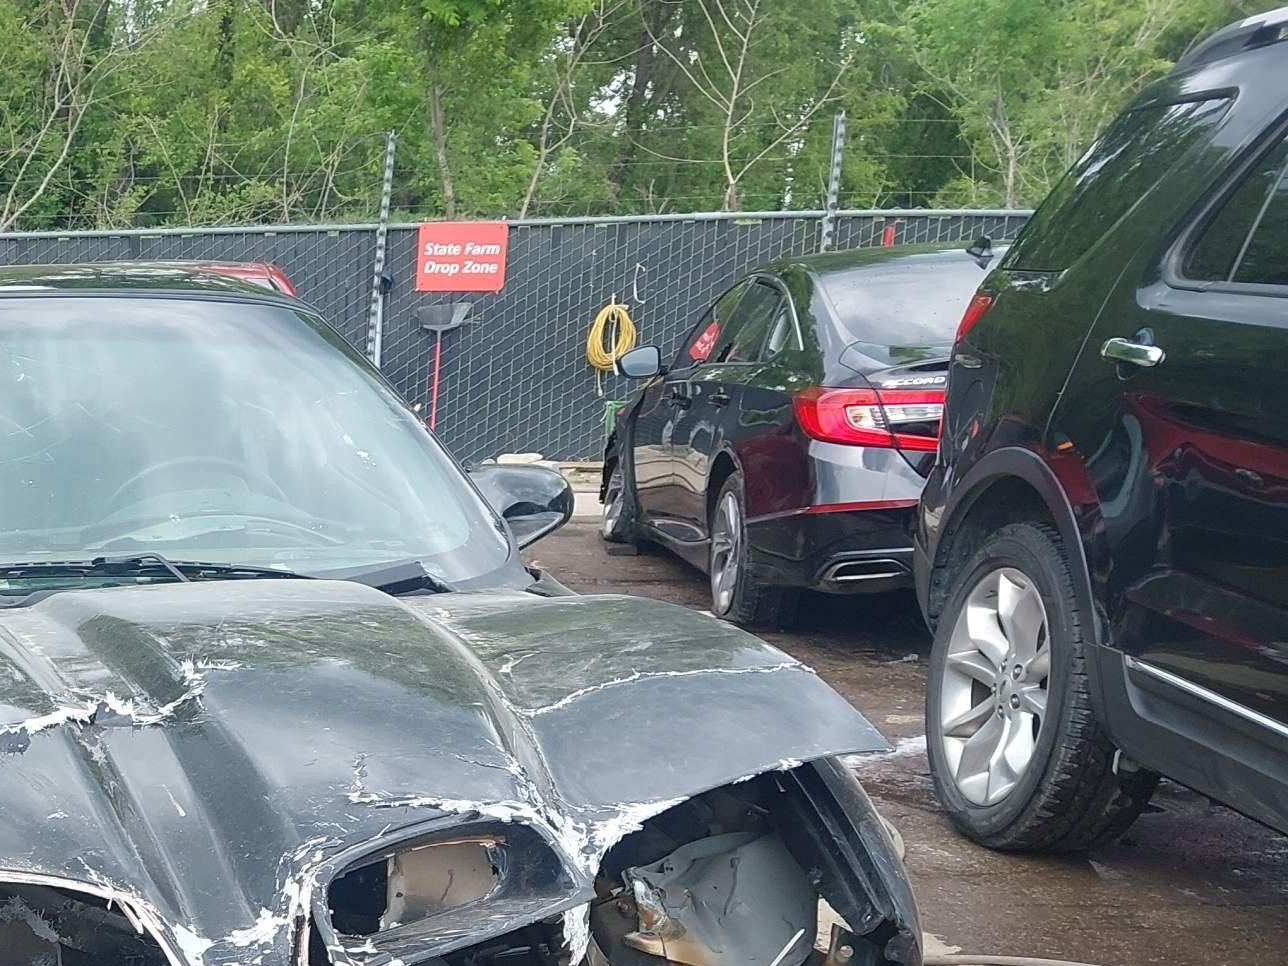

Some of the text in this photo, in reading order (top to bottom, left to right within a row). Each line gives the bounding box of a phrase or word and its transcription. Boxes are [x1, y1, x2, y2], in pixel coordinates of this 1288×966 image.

[423, 242, 501, 256] State Farm
[423, 260, 499, 277] Drop Zone
[881, 376, 946, 387] ACCORD
